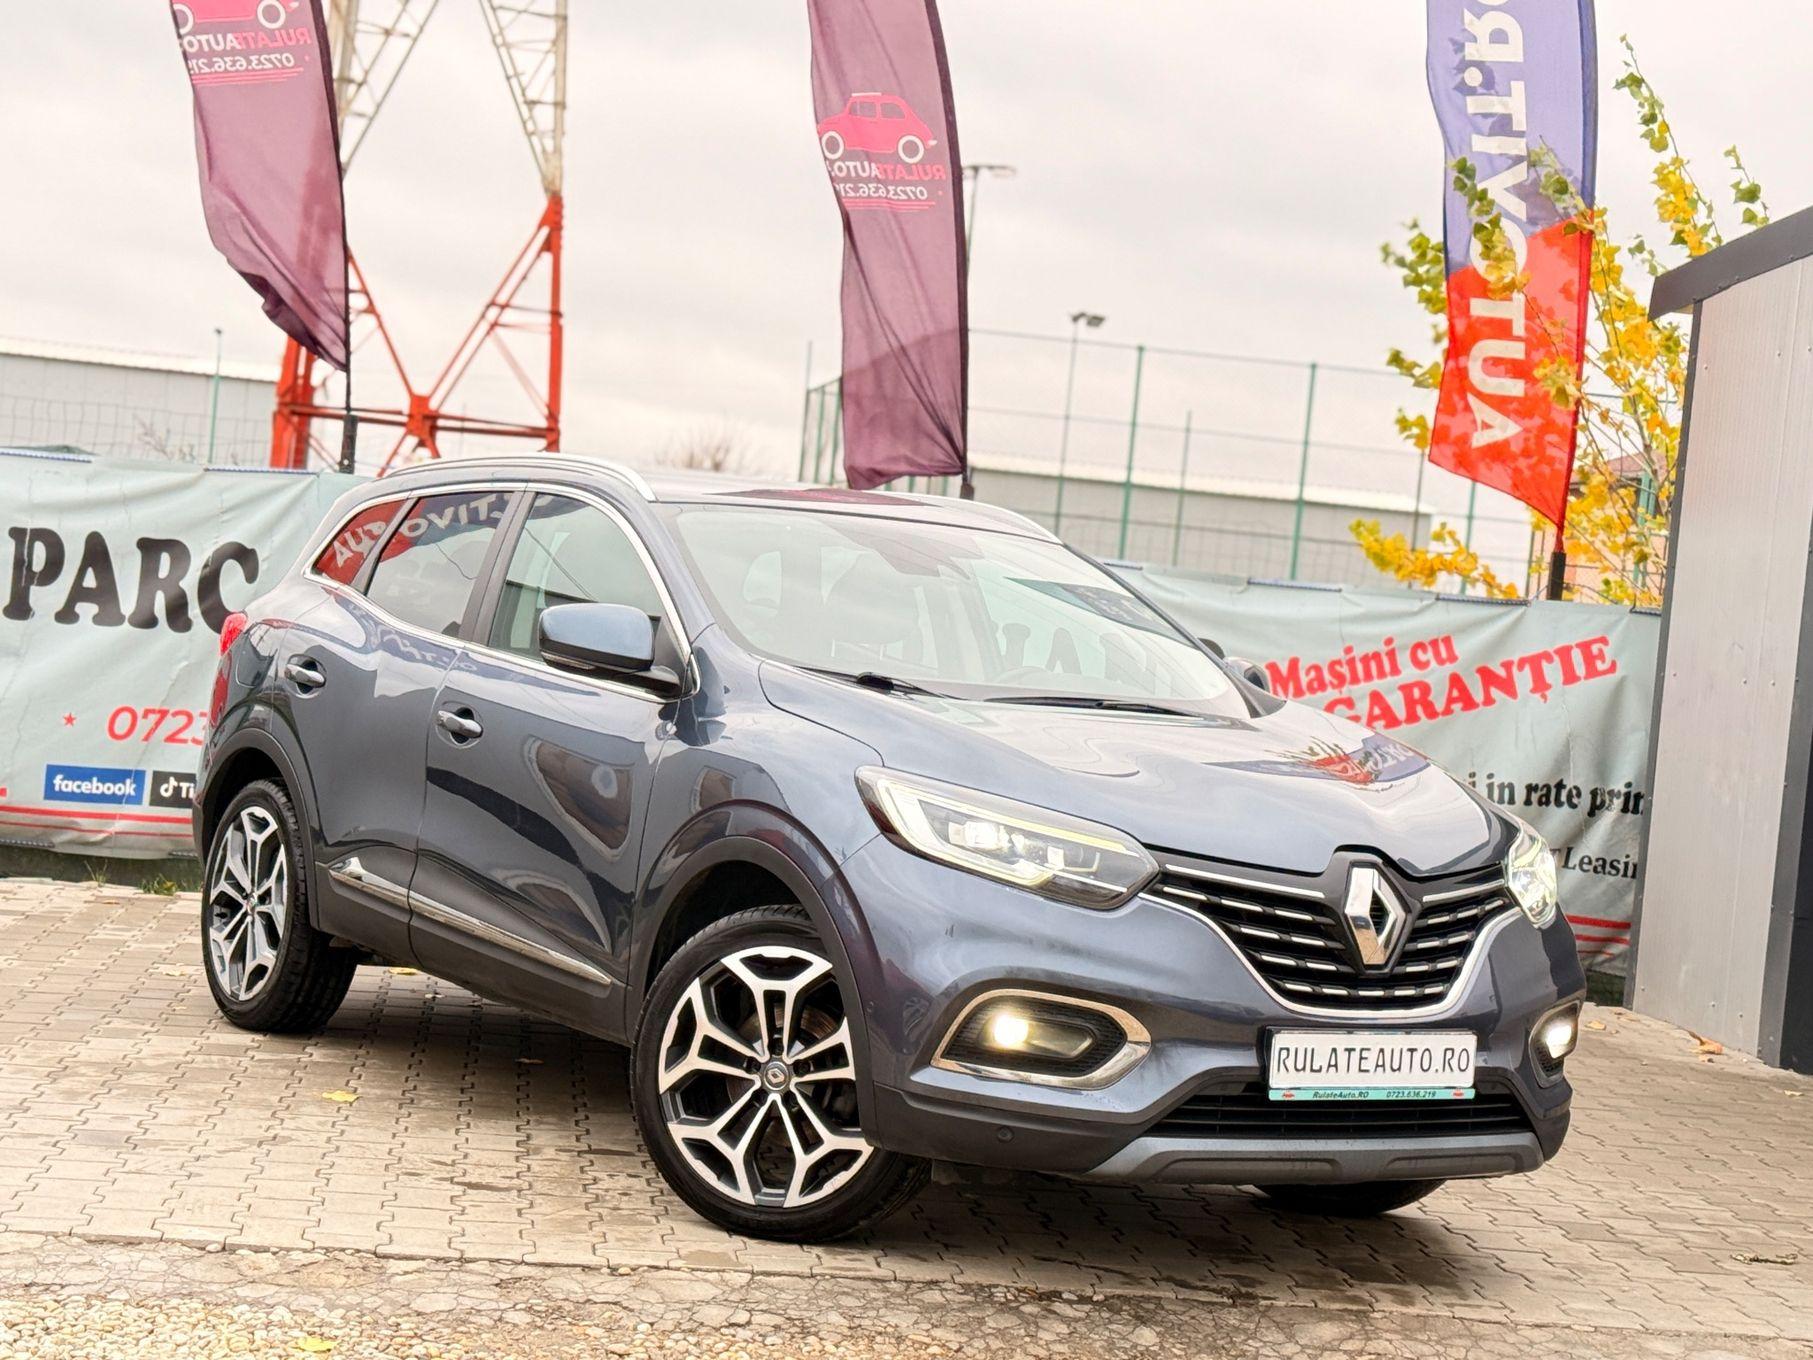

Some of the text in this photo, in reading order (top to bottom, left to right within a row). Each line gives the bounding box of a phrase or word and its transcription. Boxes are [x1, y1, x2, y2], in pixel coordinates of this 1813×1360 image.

[3, 527, 259, 634] PARC
[1409, 635, 1459, 670] cu
[53, 774, 136, 796] facebook
[1486, 773, 1516, 805] in
[1523, 778, 1582, 809] rate
[1277, 1047, 1470, 1074] RULATEAUTO.RO
